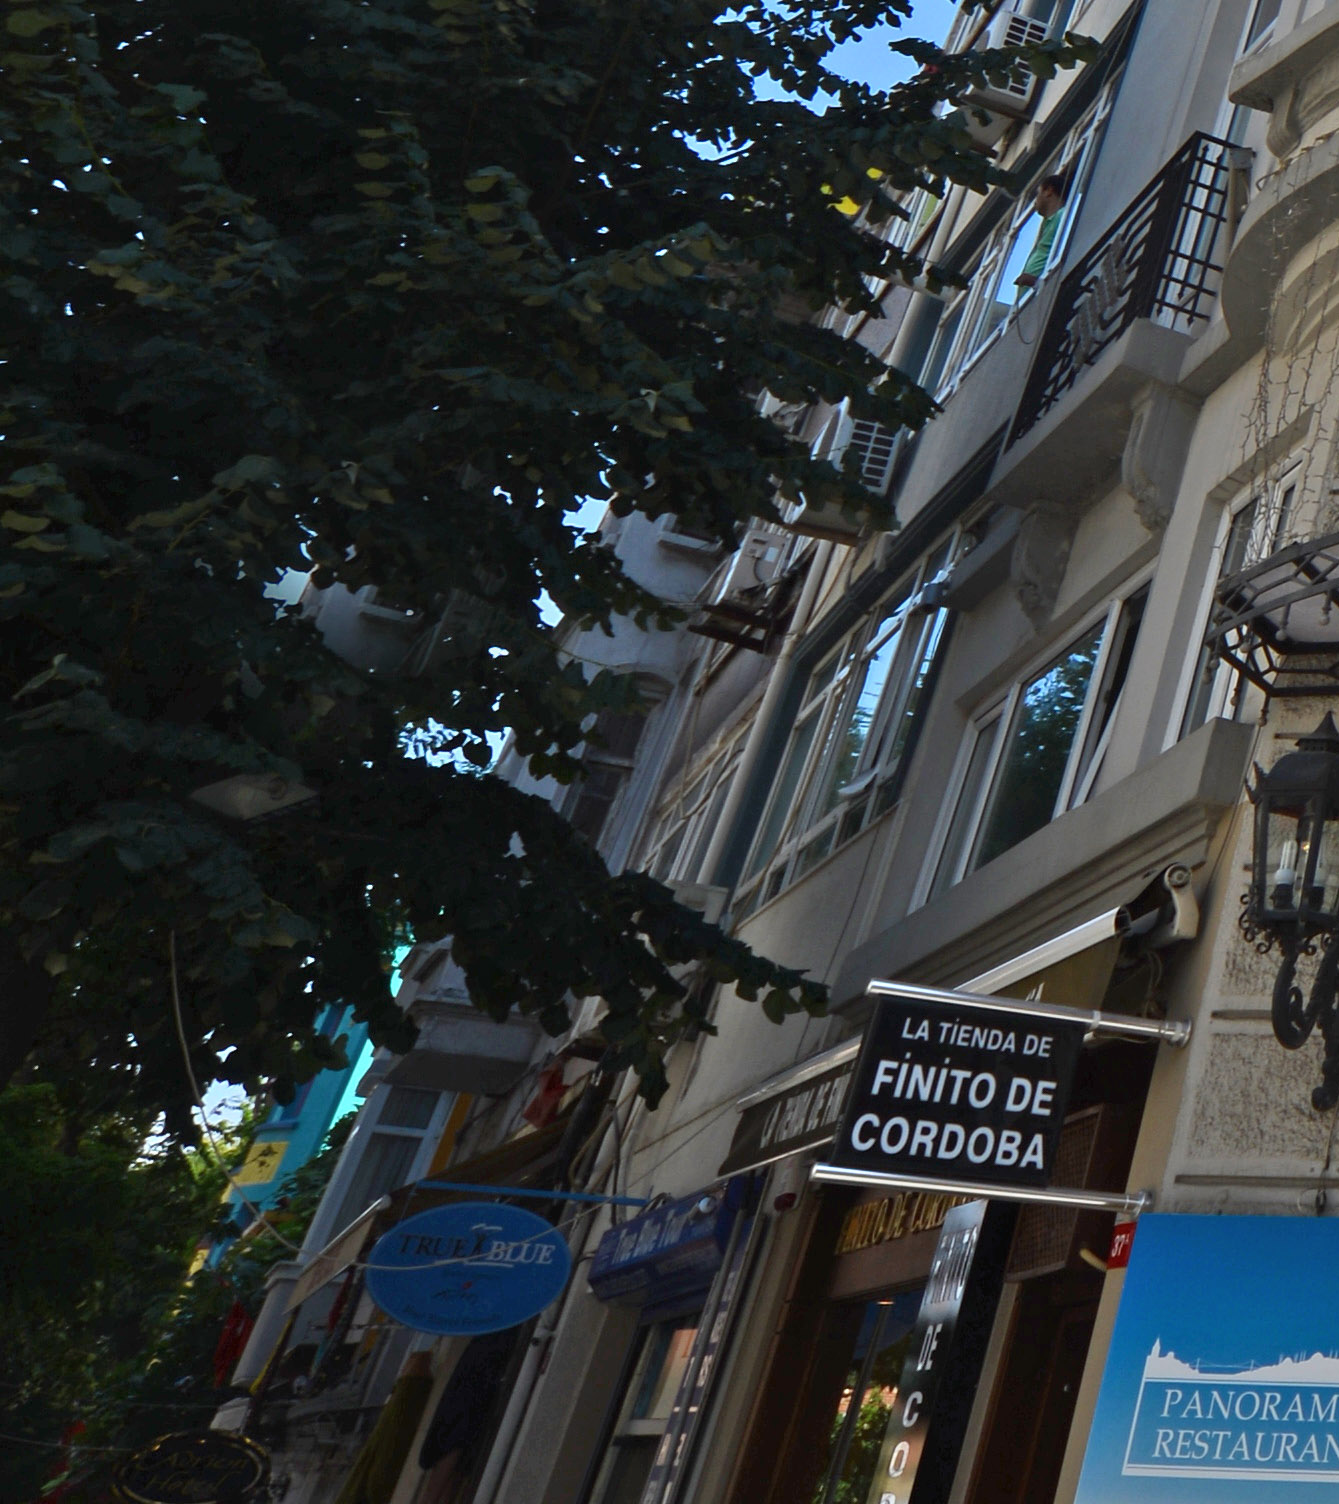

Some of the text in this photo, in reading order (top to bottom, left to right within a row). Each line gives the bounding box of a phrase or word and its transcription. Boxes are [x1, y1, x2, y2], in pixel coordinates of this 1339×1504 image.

[901, 1016, 930, 1042] LA
[1022, 1034, 1054, 1058] DE
[1005, 1076, 1057, 1117] DE
[850, 1112, 1045, 1170] CORDOBA
[400, 1234, 556, 1265] TRUE BLUE
[916, 1323, 943, 1371] DE
